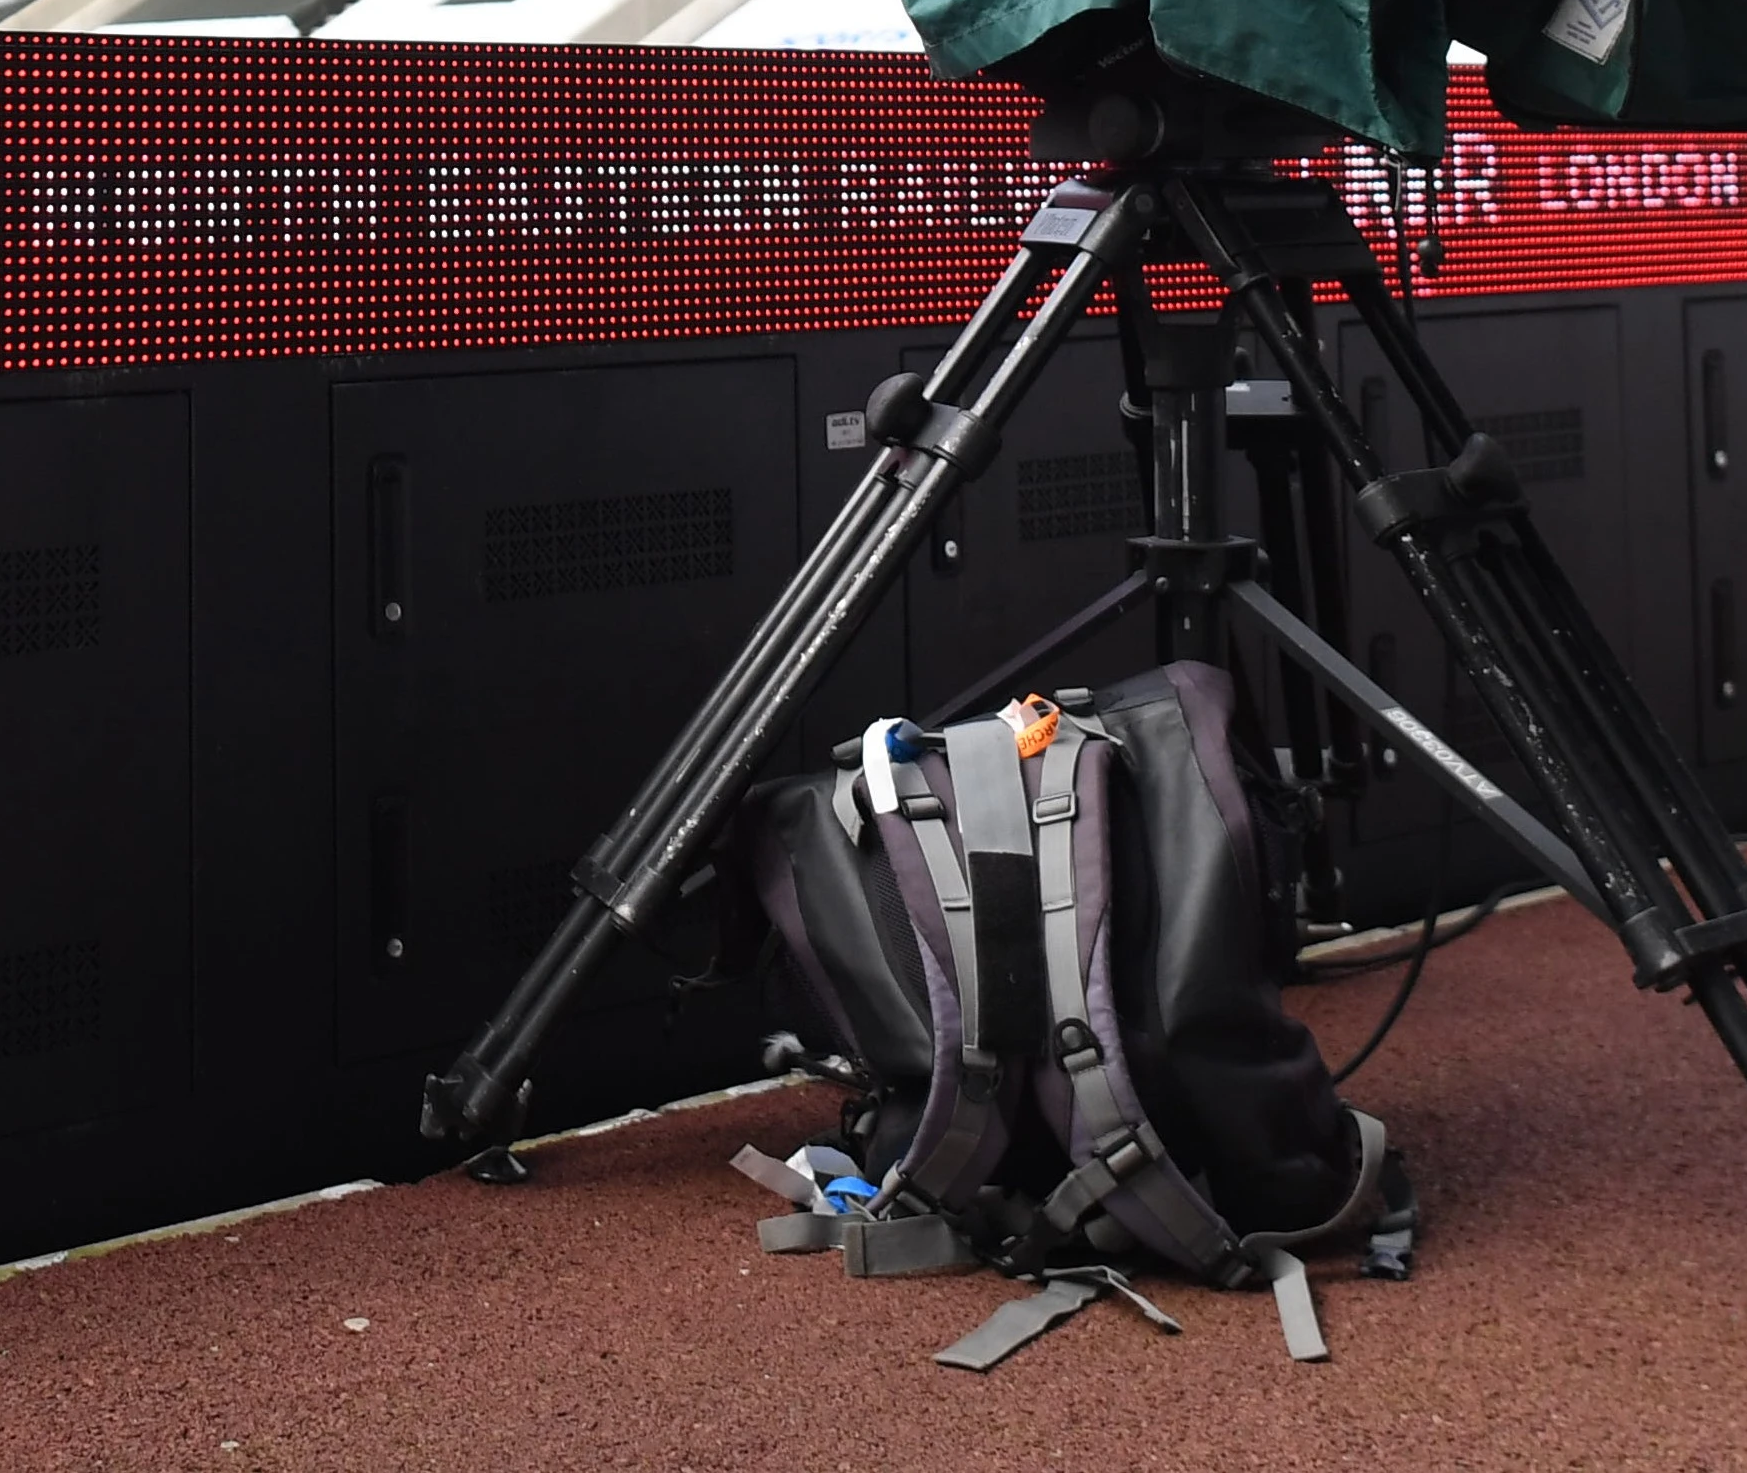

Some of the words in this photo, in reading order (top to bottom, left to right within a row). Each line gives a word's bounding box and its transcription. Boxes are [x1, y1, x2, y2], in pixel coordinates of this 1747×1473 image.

[34, 156, 378, 244] NORTH
[424, 154, 804, 238] EASTERN
[838, 152, 1092, 229] RAILW
[1537, 150, 1741, 212] LONDON
